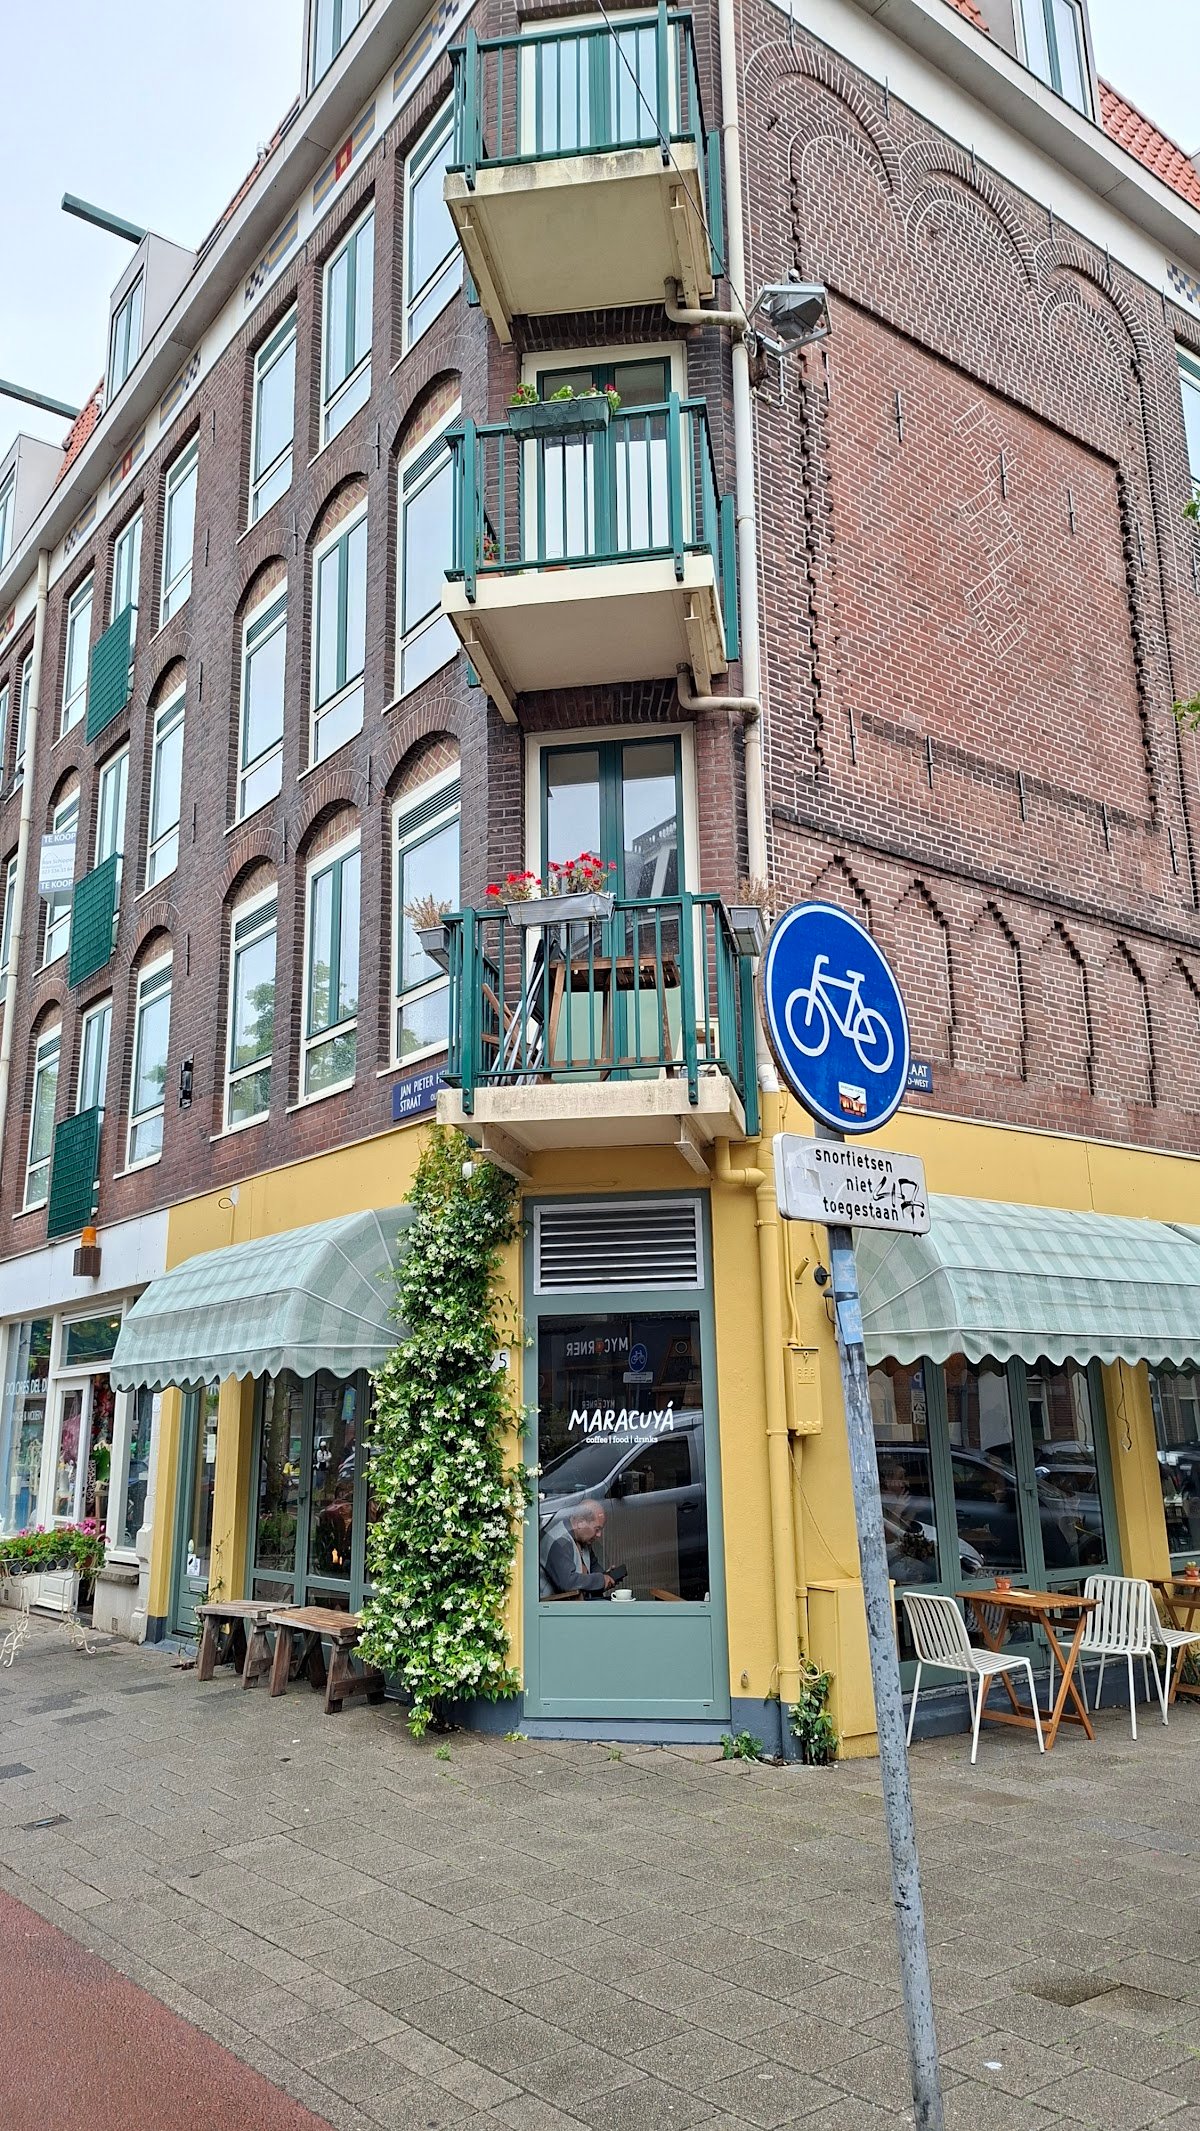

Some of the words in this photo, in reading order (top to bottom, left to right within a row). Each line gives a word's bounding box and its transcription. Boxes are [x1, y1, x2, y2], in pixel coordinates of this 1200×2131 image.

[44, 835, 53, 844] TE
[54, 832, 76, 843] KOOP
[40, 881, 50, 890] TE
[51, 879, 73, 889] KOOP
[400, 1083, 412, 1101] JAN
[413, 1074, 434, 1093] PIETER
[400, 1094, 422, 1112] STRAAT
[815, 1149, 893, 1173] snorfietsen
[846, 1176, 873, 1194] niet
[823, 1196, 899, 1222] toegestaan
[30, 1379, 40, 1393] DEL
[568, 1400, 675, 1433] MARACUYÁ
[585, 1435, 608, 1444] coffee
[613, 1435, 629, 1444] food
[634, 1435, 658, 1444] drinks
